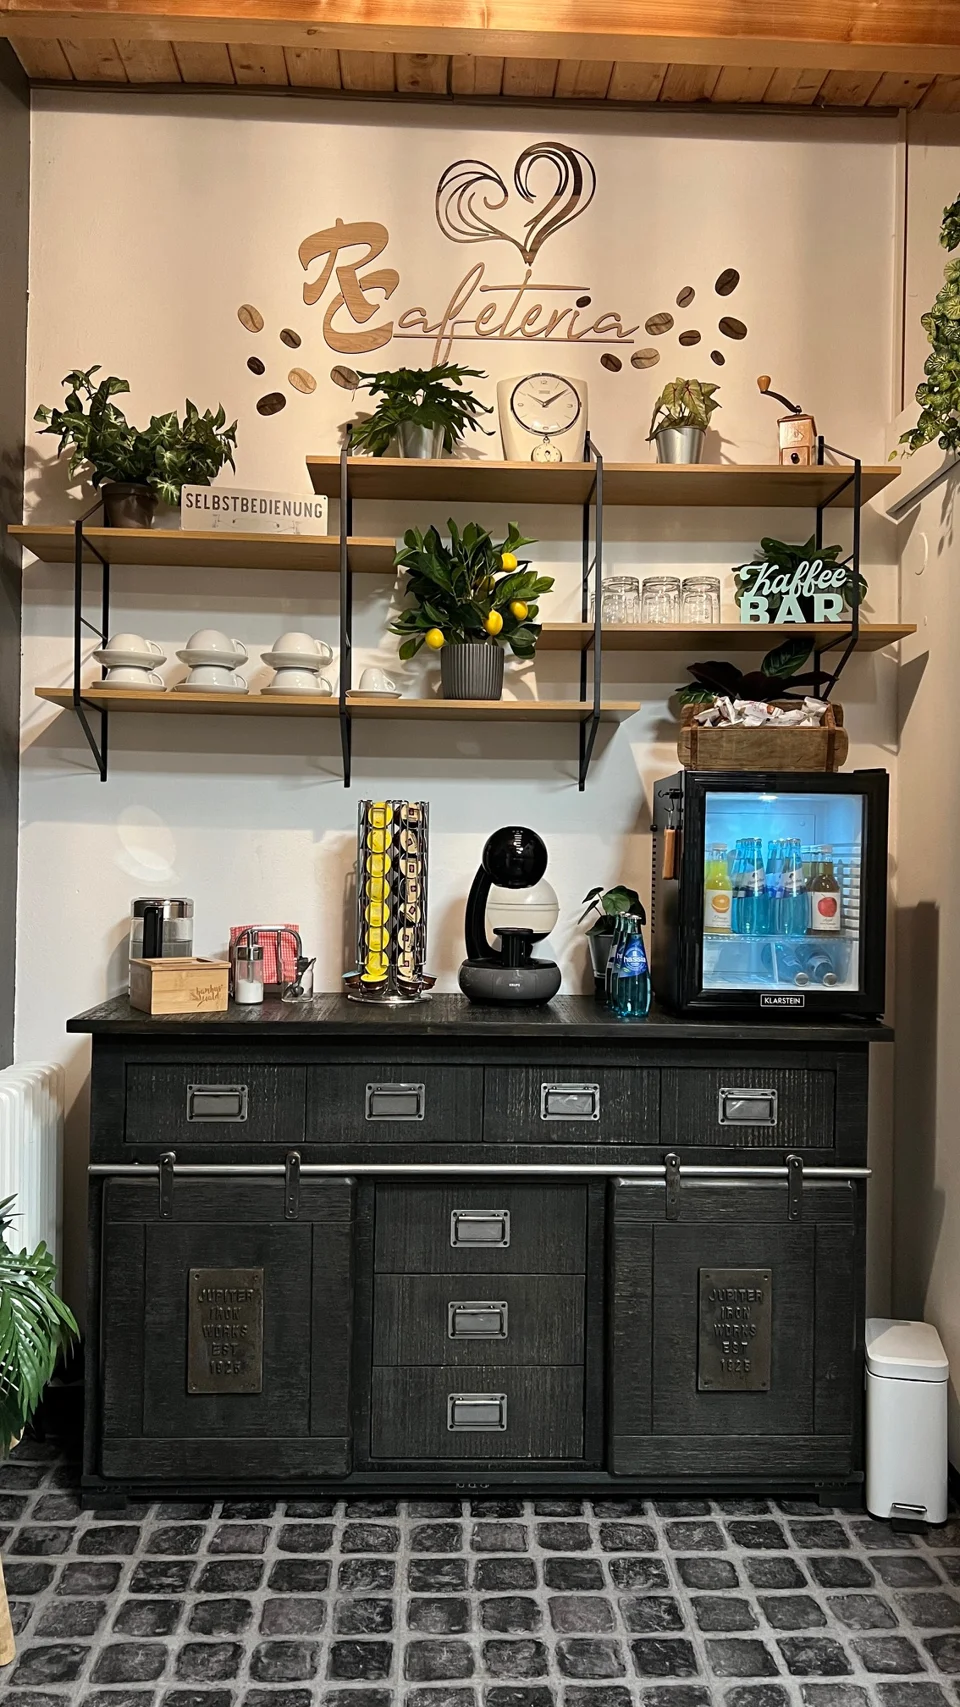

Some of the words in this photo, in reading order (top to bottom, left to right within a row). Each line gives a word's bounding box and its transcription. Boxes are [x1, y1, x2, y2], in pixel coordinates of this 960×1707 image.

[185, 492, 323, 519] SELBSTBEDIENUNG
[740, 559, 848, 598] Kaffee
[739, 592, 843, 625] BAR
[764, 996, 801, 1005] KLARSTEIN
[198, 1288, 254, 1303] JUPITER
[708, 1288, 763, 1304] JUPITER
[720, 1306, 751, 1320] IRON
[202, 1324, 249, 1339] WORKS
[713, 1323, 757, 1338] WORKS
[211, 1341, 240, 1356] EST
[722, 1341, 748, 1354] EST
